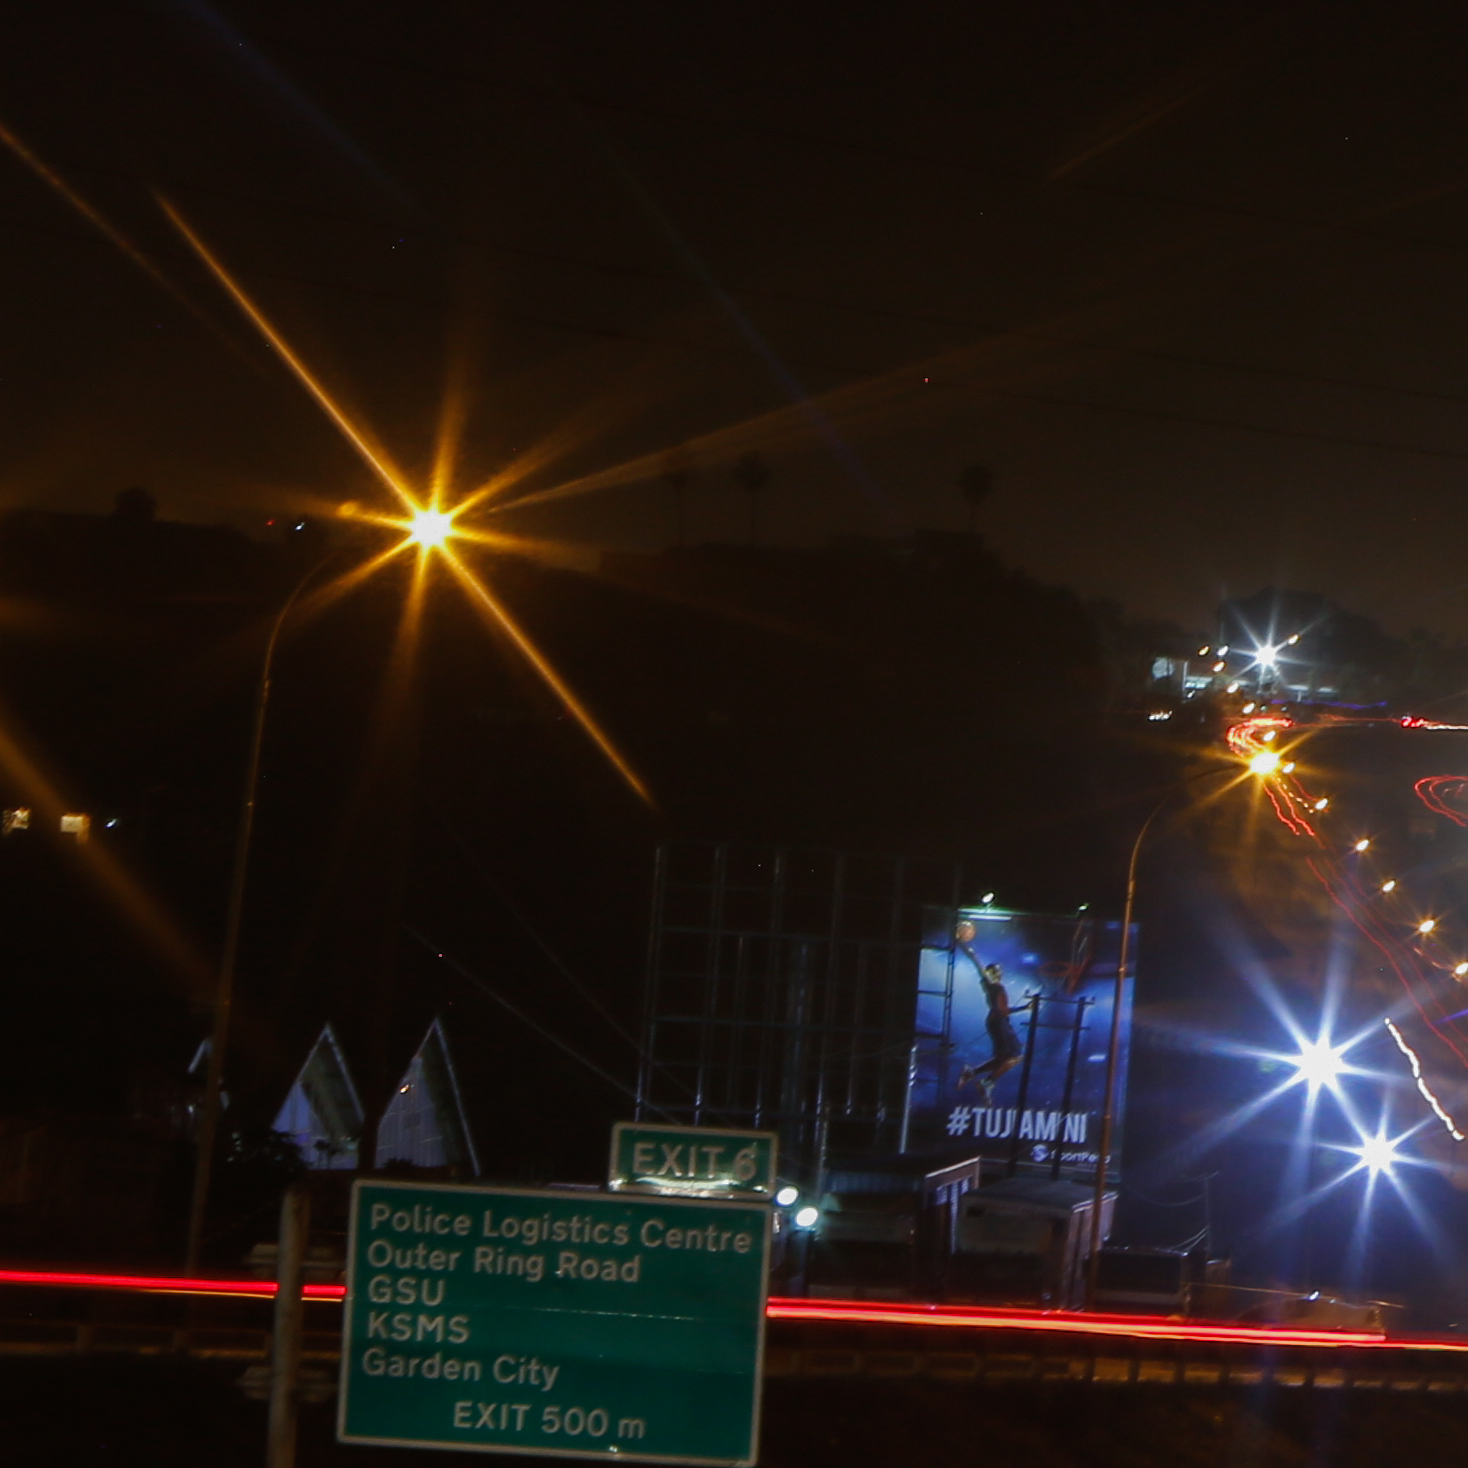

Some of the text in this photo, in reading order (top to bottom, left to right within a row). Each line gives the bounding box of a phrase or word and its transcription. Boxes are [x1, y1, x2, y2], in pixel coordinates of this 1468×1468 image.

[633, 1142, 757, 1181] EXIT 6
[370, 1203, 751, 1253] Police Logistics Centre
[367, 1239, 641, 1282] Outer Ring Road
[368, 1274, 445, 1306] GSU
[367, 1311, 470, 1343] KSMS
[363, 1347, 560, 1392] Garden City
[453, 1400, 645, 1439] EXIT 500 m
